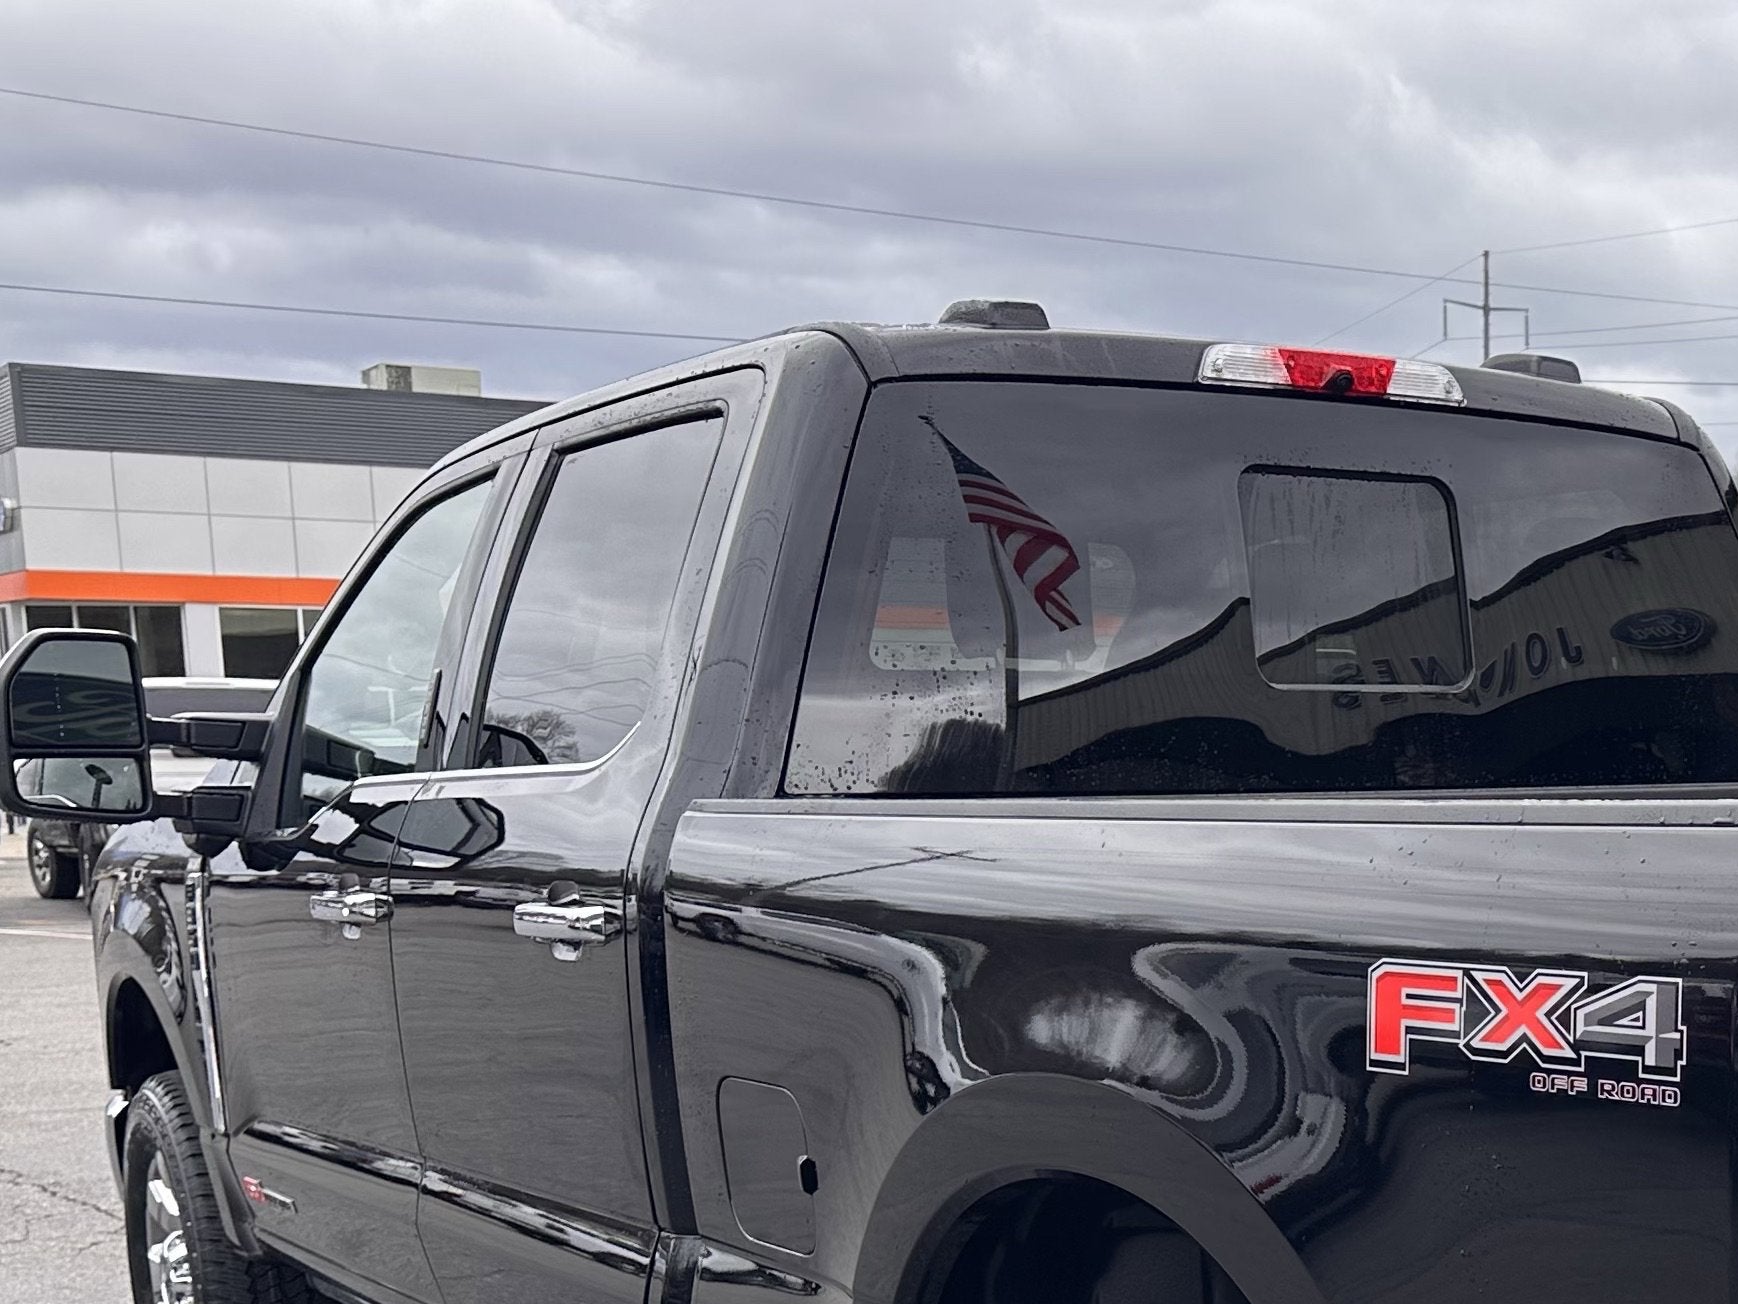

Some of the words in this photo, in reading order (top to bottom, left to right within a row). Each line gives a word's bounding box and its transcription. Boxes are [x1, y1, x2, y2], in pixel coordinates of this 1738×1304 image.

[1366, 958, 1687, 1081] FX4
[1529, 1071, 1588, 1096] OFF
[1597, 1078, 1682, 1108] ROAD
